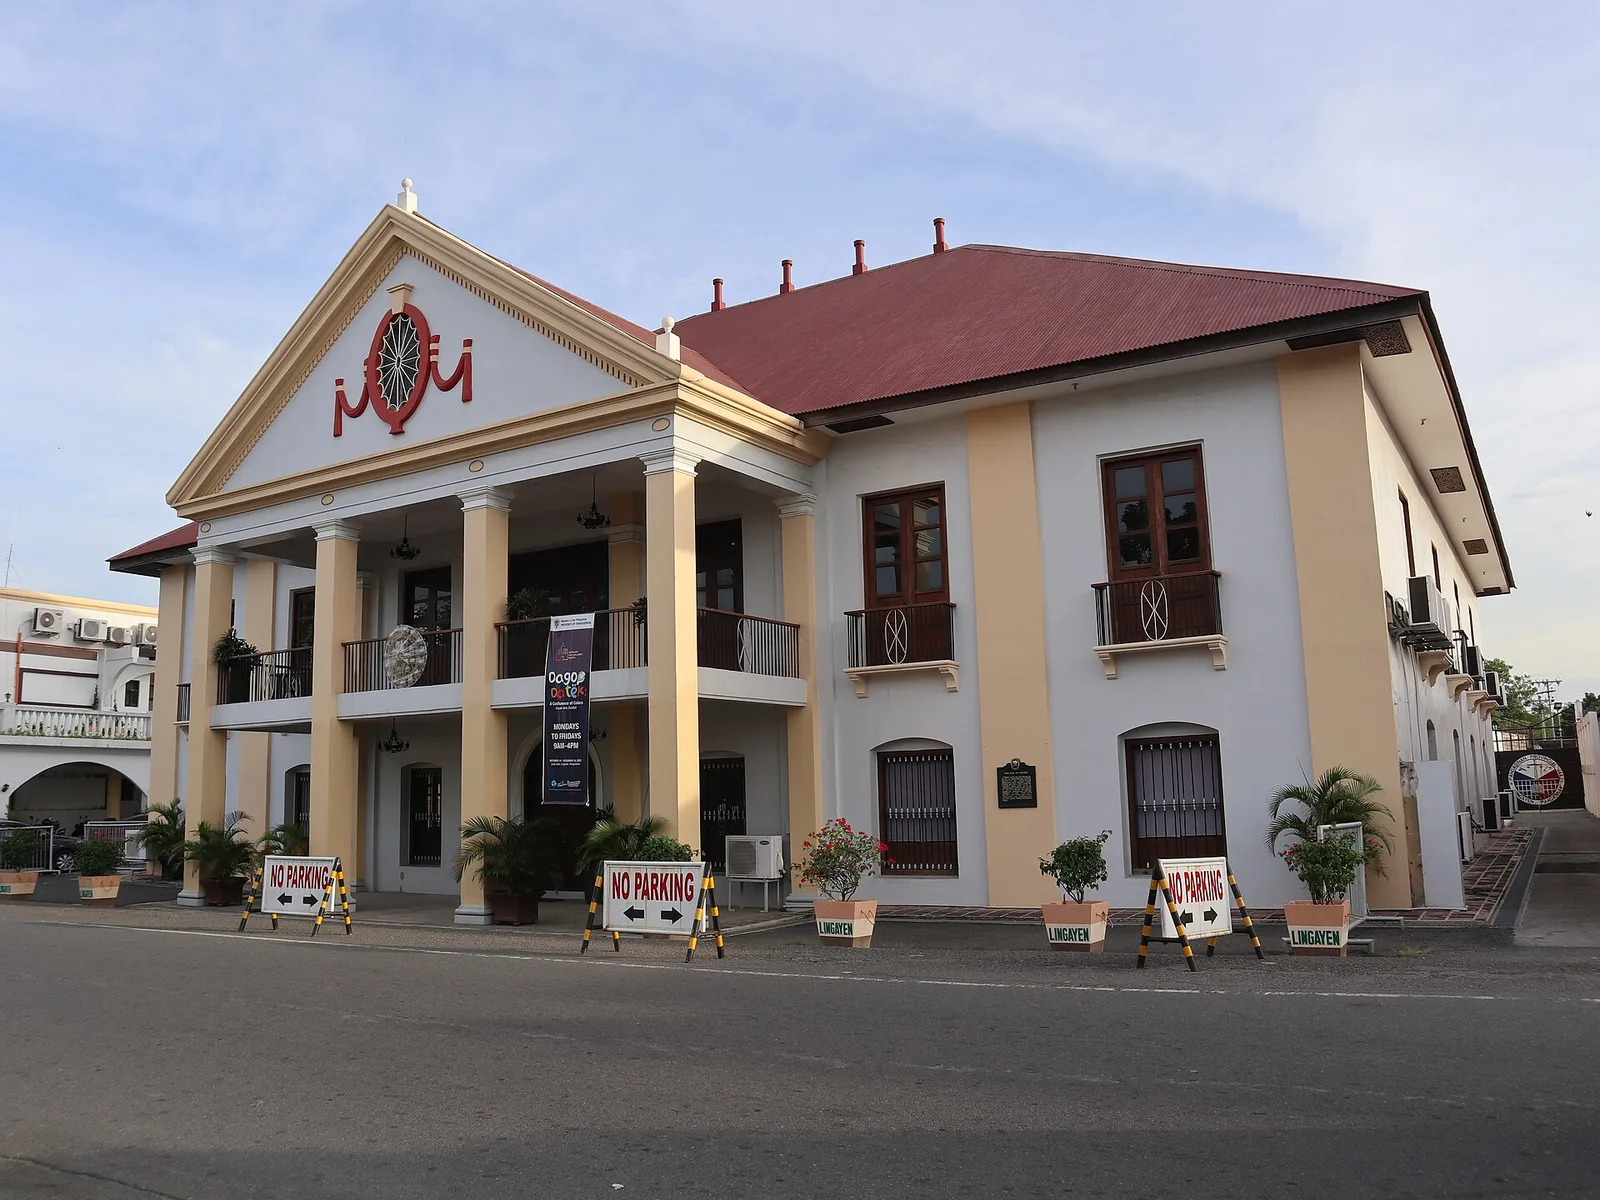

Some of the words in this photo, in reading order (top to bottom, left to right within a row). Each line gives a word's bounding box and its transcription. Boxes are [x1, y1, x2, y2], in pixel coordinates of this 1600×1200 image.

[548, 671, 586, 686] Dagop
[270, 865, 284, 888] NO
[286, 866, 328, 890] PARKING
[612, 872, 630, 900] NO
[634, 872, 694, 902] PARKING
[1168, 872, 1182, 904] NO
[1184, 870, 1223, 903] PARKING
[819, 921, 853, 935] LINGAYEN
[1049, 928, 1089, 942] LINGAYEN
[1292, 930, 1340, 946] LINGAYEN
